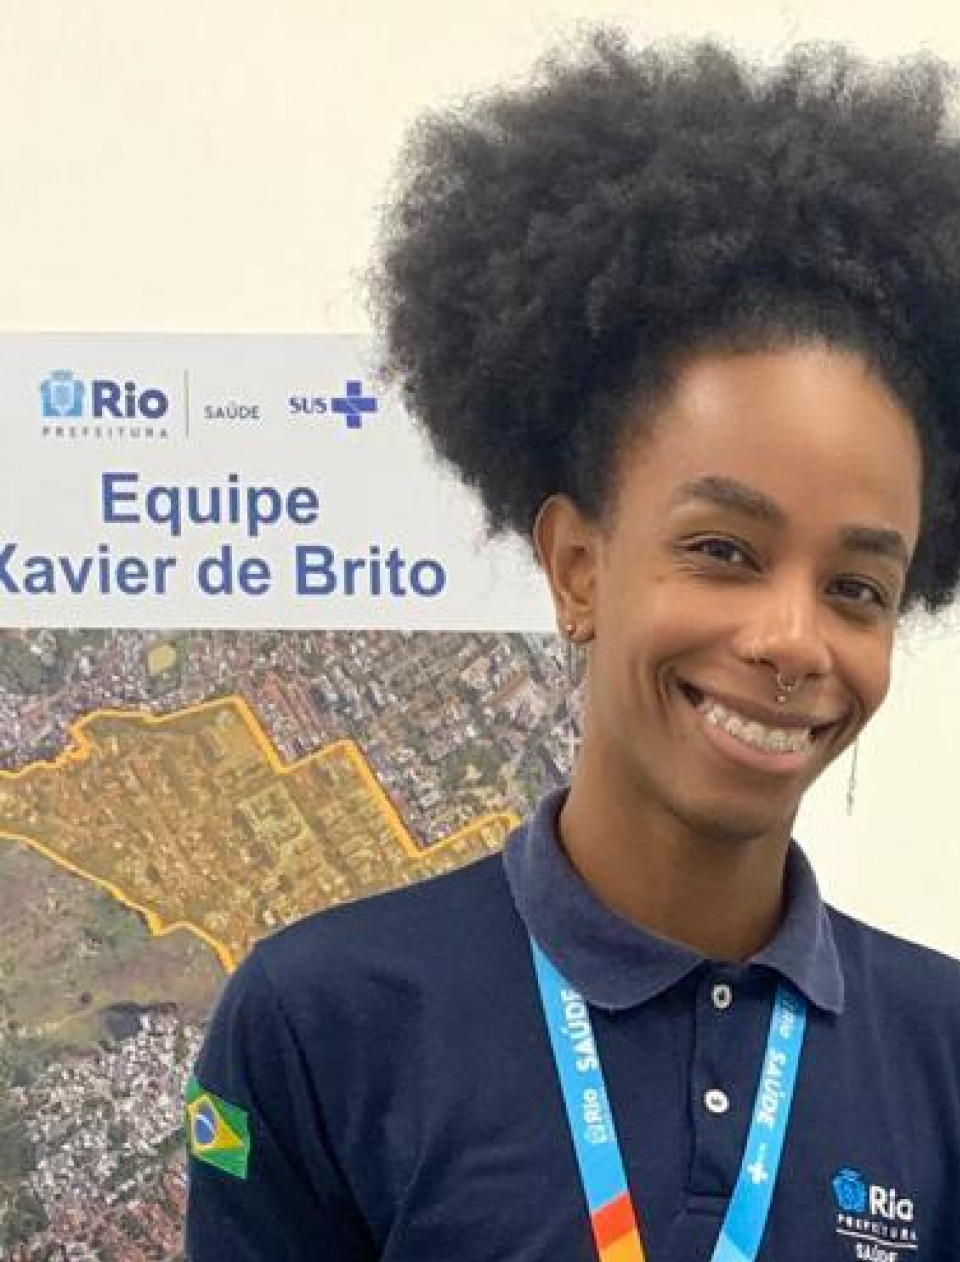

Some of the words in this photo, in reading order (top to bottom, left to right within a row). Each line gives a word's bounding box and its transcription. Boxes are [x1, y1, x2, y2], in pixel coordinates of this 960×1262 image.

[92, 379, 169, 419] Rio
[203, 402, 261, 420] SAÚDE
[288, 396, 328, 414] SUS
[42, 427, 169, 438] PREFEITURA
[102, 472, 320, 537] Equipe
[198, 544, 271, 596] de
[295, 544, 447, 597] Brito
[869, 1185, 914, 1222] Rio
